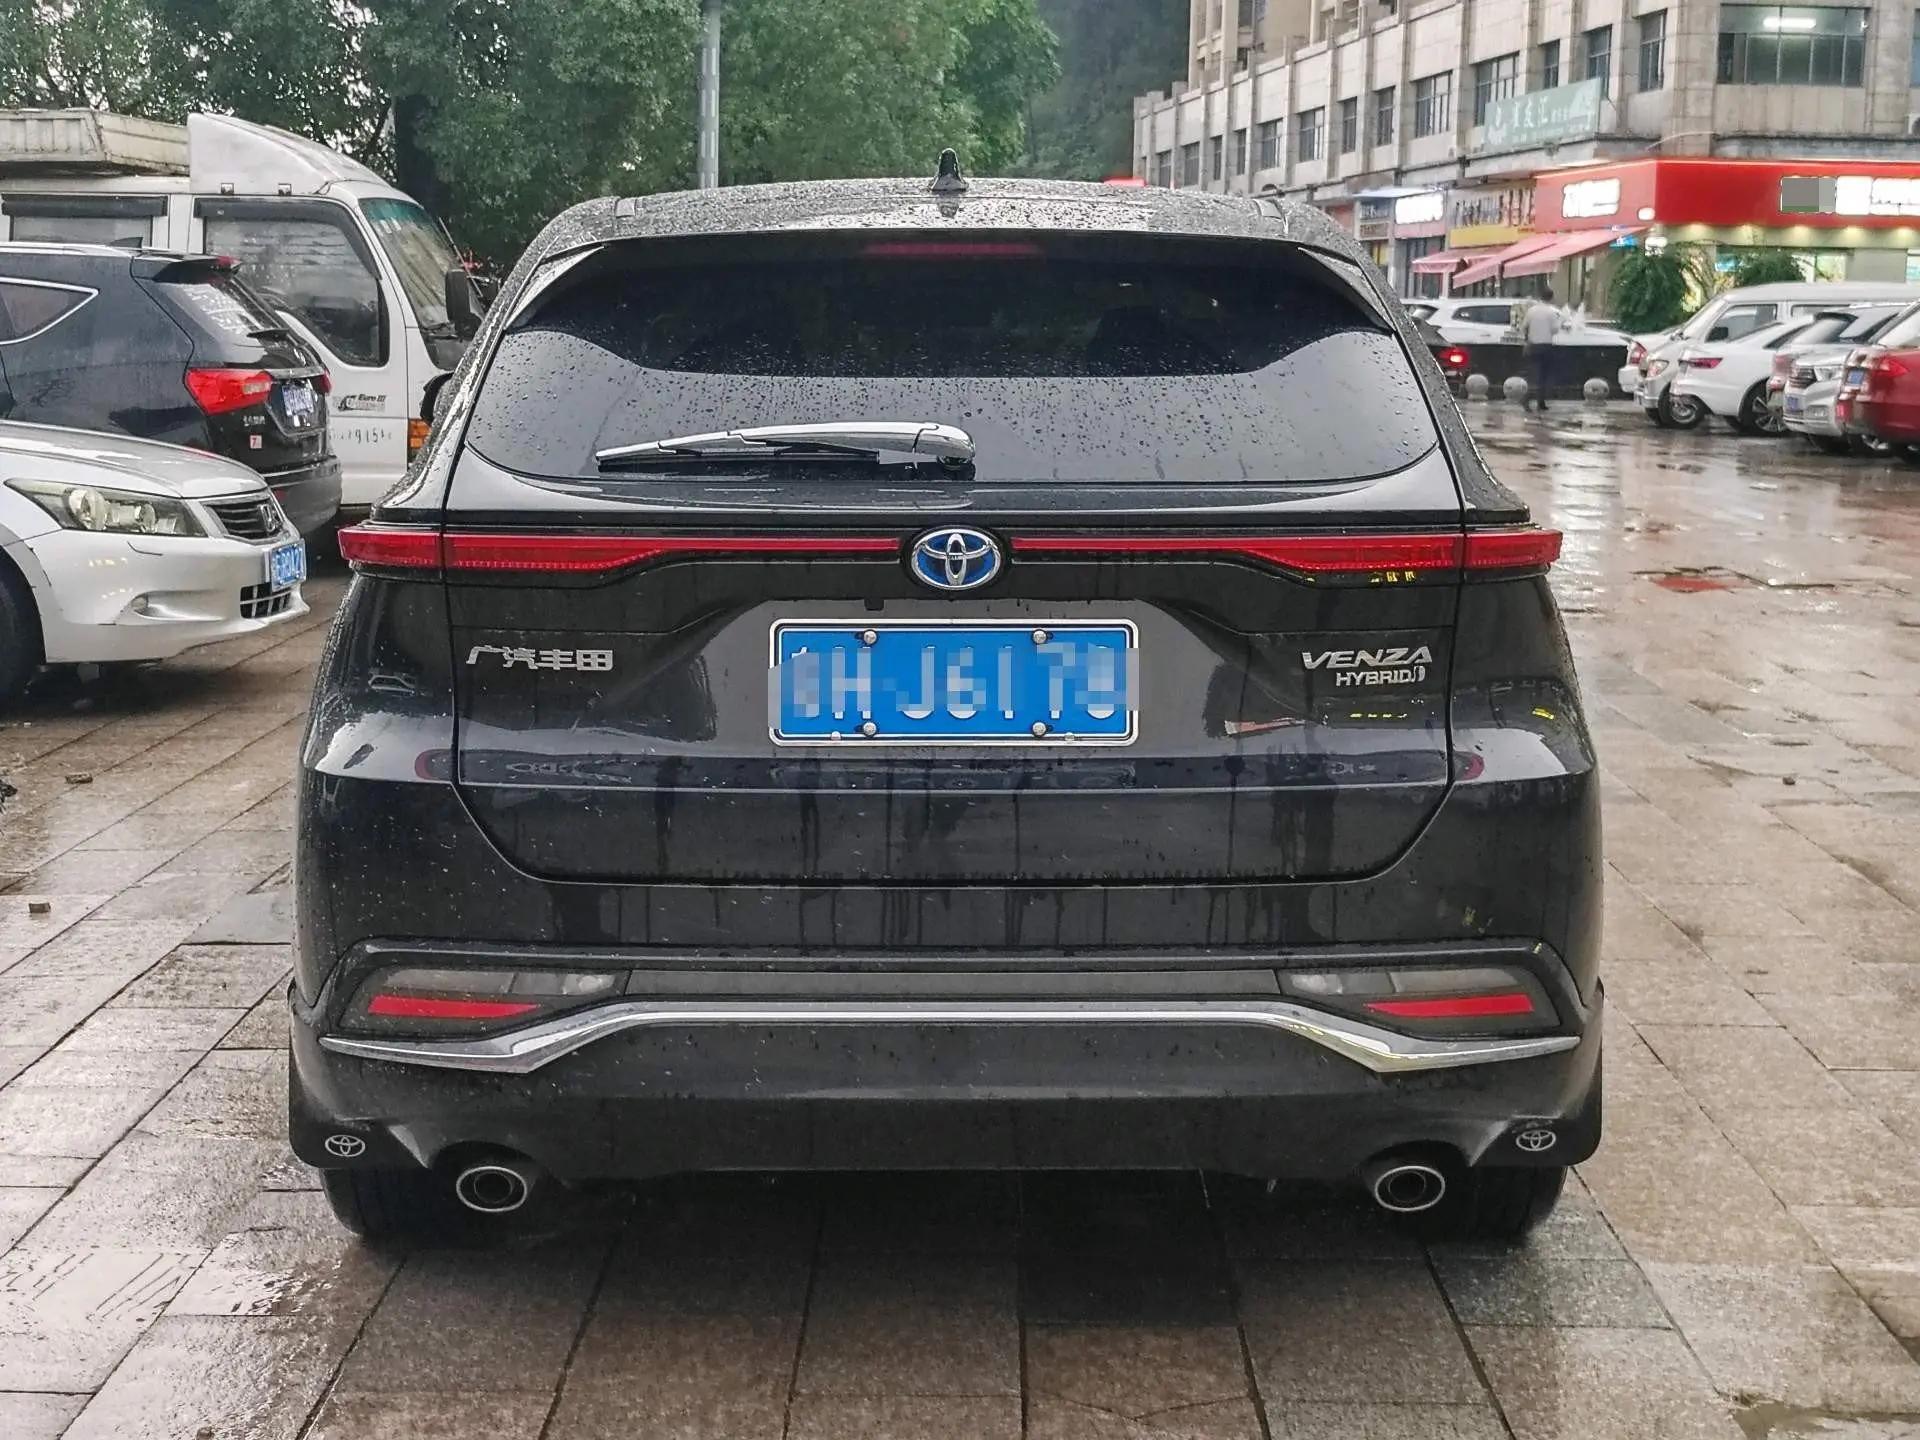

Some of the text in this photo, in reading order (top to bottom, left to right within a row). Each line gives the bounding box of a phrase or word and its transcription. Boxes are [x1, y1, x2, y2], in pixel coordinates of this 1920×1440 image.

[465, 644, 614, 671] 广汽丰田
[1302, 646, 1433, 670] VENZA
[1336, 668, 1415, 687] HYBRID
